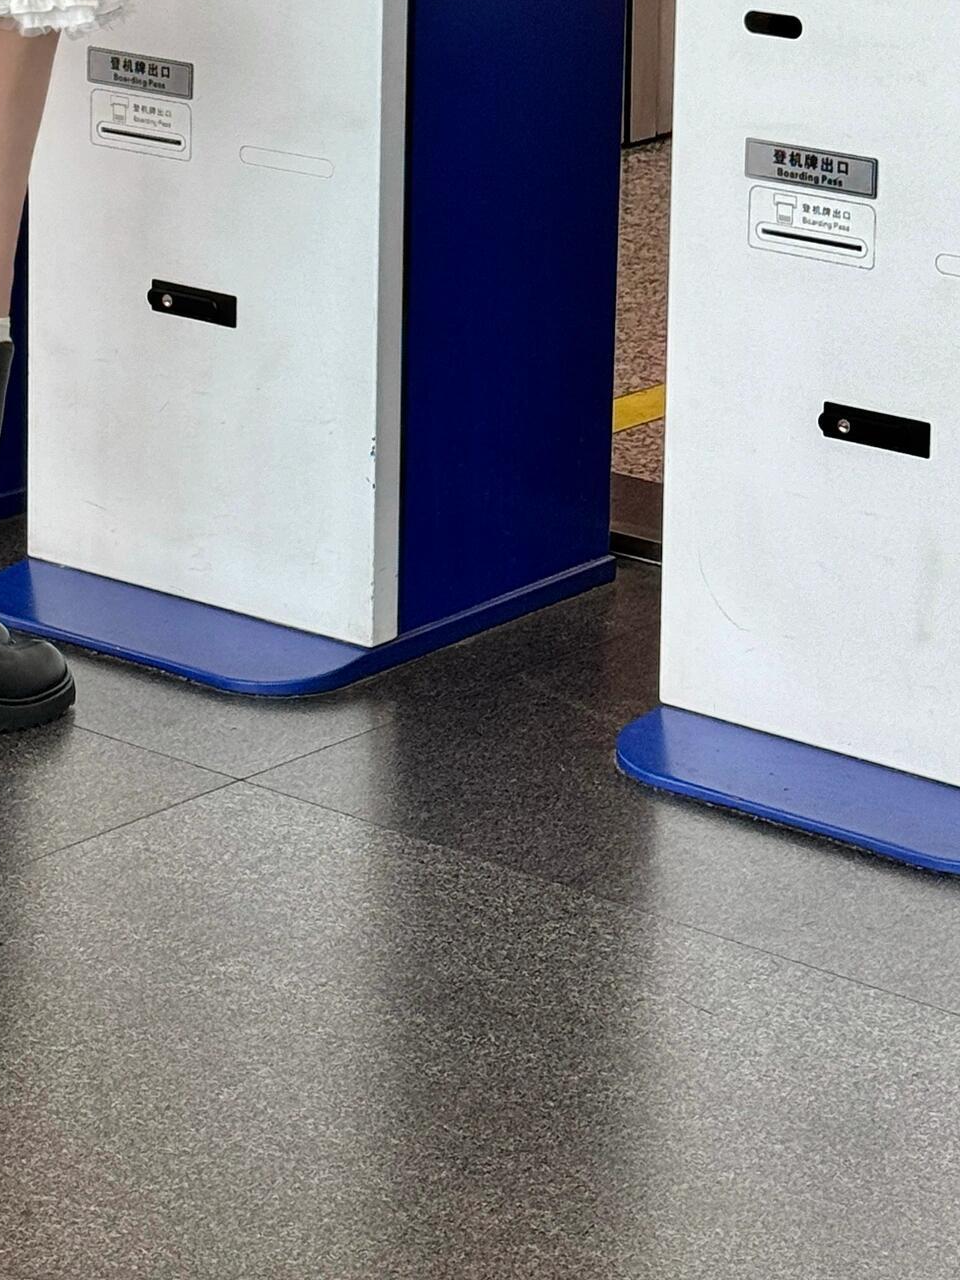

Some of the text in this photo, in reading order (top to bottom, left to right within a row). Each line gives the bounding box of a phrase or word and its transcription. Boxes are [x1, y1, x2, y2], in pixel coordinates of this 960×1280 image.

[110, 56, 172, 80] 登机牌出口
[113, 72, 167, 90] Boarding Pass
[772, 148, 850, 177] 登机牌出口
[776, 166, 844, 188] Boarding Pass
[801, 202, 852, 221] 登机牌出口
[802, 216, 851, 233] Boarding Pass
